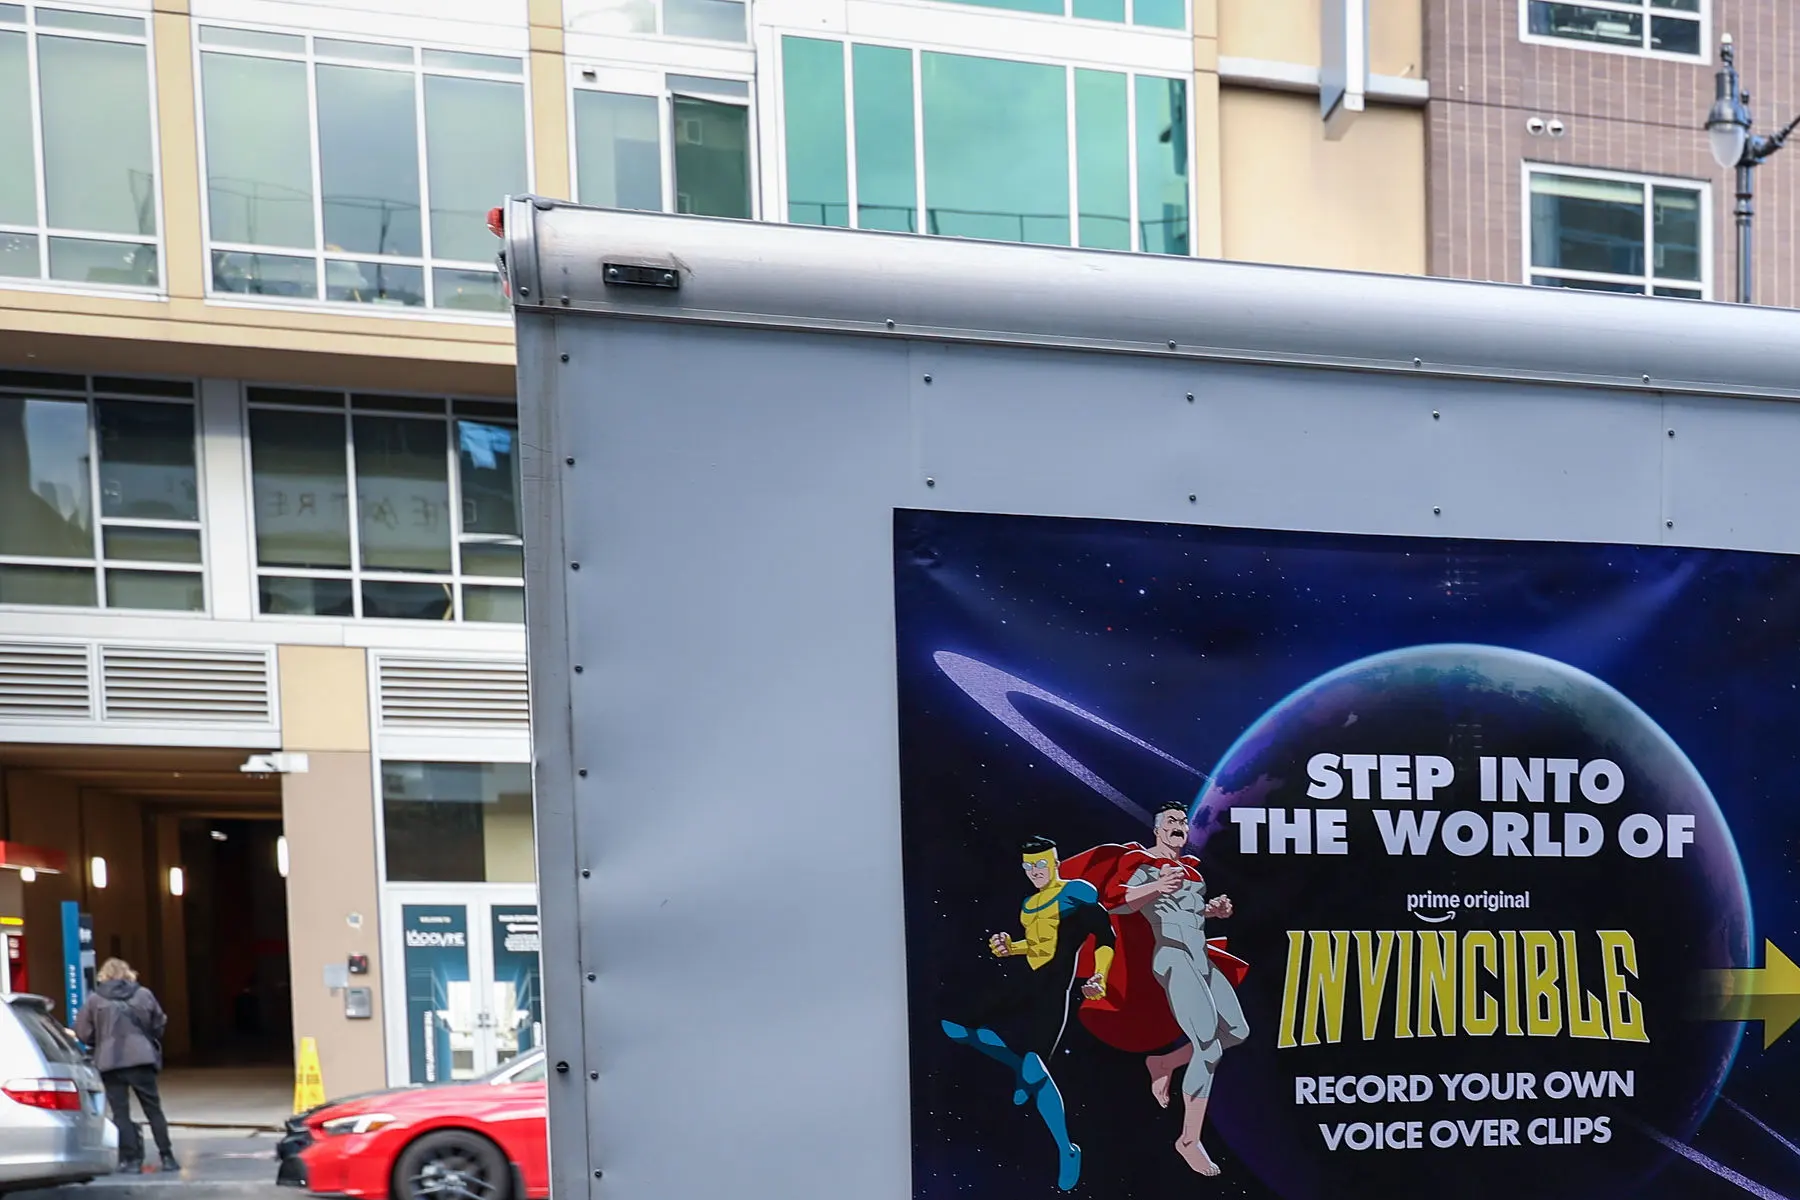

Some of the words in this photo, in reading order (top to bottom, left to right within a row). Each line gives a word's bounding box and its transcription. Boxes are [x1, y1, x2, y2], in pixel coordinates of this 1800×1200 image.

[1305, 753, 1454, 801] STEP
[1480, 756, 1625, 804] INTO
[1230, 807, 1348, 855] THE
[1372, 810, 1605, 858] WORLD
[1618, 813, 1696, 859] OF
[1406, 890, 1460, 912] prime
[1464, 890, 1530, 912] original
[1277, 930, 1651, 1049] INVINCIBLE
[1295, 1075, 1433, 1104] RECORD
[1438, 1072, 1538, 1101] YOUR
[1543, 1070, 1635, 1099] OWN
[1319, 1122, 1423, 1151] VOICE
[1430, 1118, 1520, 1149] OVER
[1527, 1116, 1612, 1146] CLIPS
